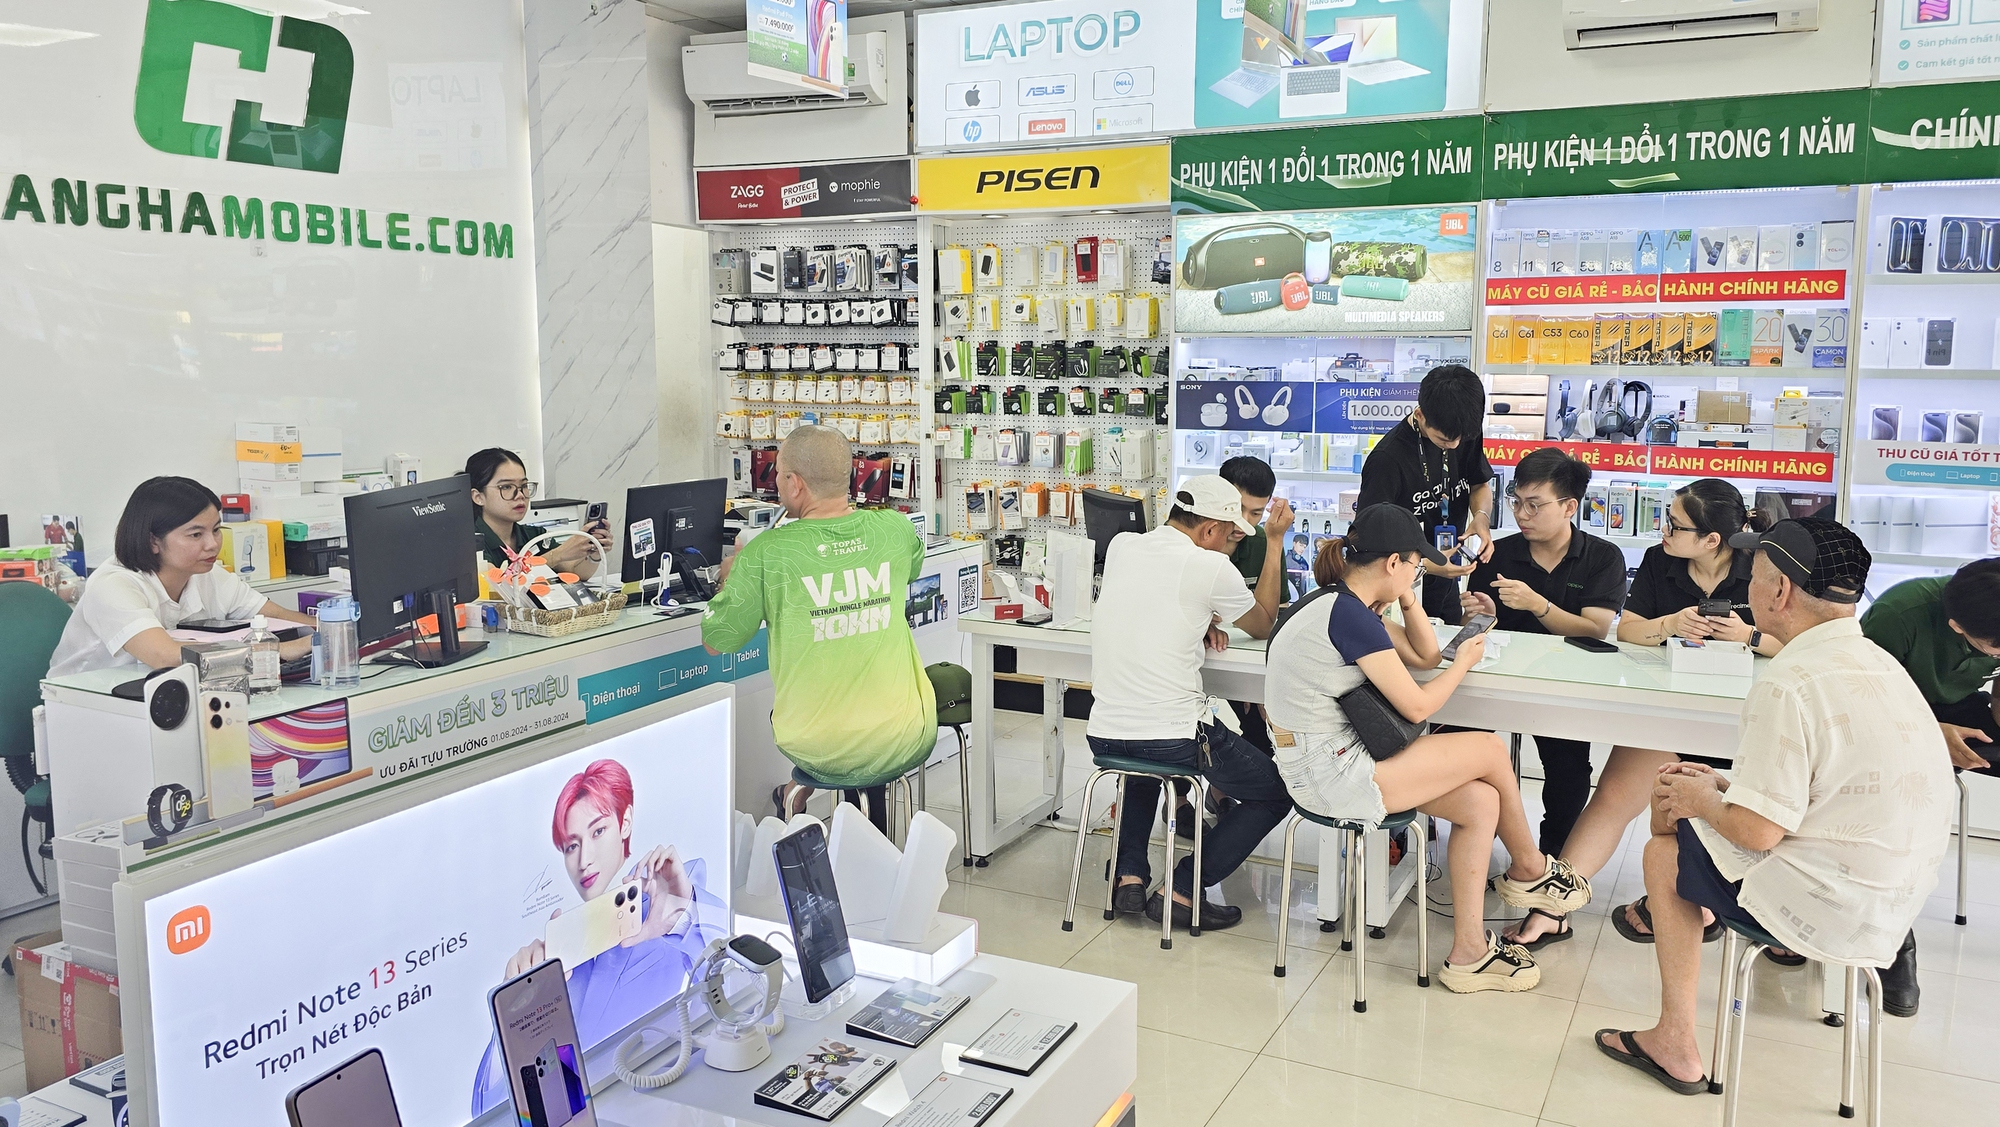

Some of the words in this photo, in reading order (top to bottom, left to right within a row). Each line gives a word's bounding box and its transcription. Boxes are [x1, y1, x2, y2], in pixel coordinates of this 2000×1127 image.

[1229, 6, 1245, 14] CHÍN
[963, 9, 1142, 63] LAPTOP
[1917, 38, 1936, 48] Sản
[1938, 36, 1968, 48] phẩm
[1970, 34, 1993, 44] chất
[1916, 60, 1938, 68] Cam
[1940, 57, 1956, 66] kết
[1958, 56, 1974, 68] giá
[1977, 56, 1991, 64] tốt
[1026, 84, 1066, 97] ASUS
[1115, 80, 1132, 88] DELL
[1031, 122, 1064, 132] Lenovo
[1108, 116, 1144, 128] Microsoft
[965, 120, 980, 142] hp
[1494, 142, 1538, 176] PHỤ
[1544, 134, 1595, 174] KIỆN
[1602, 138, 1612, 165] 1
[1620, 124, 1660, 164] ĐỔI
[1668, 133, 1677, 162] 1
[1686, 128, 1771, 160] TRONG
[1779, 127, 1789, 156] 1
[1798, 117, 1856, 156] NĂM
[1180, 162, 1216, 194] PHỤ
[1221, 155, 1262, 192] KIỆN
[1268, 158, 1276, 184] 1
[1282, 146, 1315, 183] ĐỔI
[1320, 156, 1330, 181] 1
[1335, 150, 1404, 180] TRONG
[1410, 150, 1420, 176] 1
[1426, 141, 1472, 176] NĂM
[840, 178, 880, 192] mophie
[976, 165, 1100, 194] PISEN
[730, 184, 764, 198] ZAGG
[783, 181, 816, 196] PROTECT
[791, 192, 818, 205] POWER
[1446, 218, 1464, 230] JBL
[1494, 260, 1502, 272] 8
[1522, 260, 1533, 272] 11
[1551, 261, 1564, 272] 12
[1315, 290, 1334, 302] JBL
[1488, 282, 1522, 300] MÁY
[1526, 284, 1550, 299] CŨ
[1554, 282, 1584, 298] GIÁ
[1589, 280, 1607, 298] RẺ
[1622, 280, 1657, 296] BẢO
[1664, 279, 1714, 296] HÀNH
[1720, 278, 1778, 295] CHÍNH
[1784, 278, 1839, 294] HÃNG
[1250, 290, 1272, 305] JBL
[1290, 292, 1308, 303] JBL
[1344, 310, 1396, 324] MULTIMEDIA
[1399, 310, 1445, 322] SPEAKERS
[1492, 330, 1508, 338] C61
[1518, 330, 1534, 338] C61
[1542, 328, 1562, 338] C53
[1569, 329, 1589, 338] C60
[1754, 316, 1782, 342] 20
[1816, 316, 1846, 342] 30
[1636, 350, 1650, 364] 12
[1666, 350, 1681, 364] 12
[1698, 350, 1714, 364] 12
[1340, 388, 1359, 398] PHỤ
[1360, 387, 1382, 398] KIỆN
[1351, 404, 1419, 417] 1.000.00
[1484, 445, 1516, 460] MÁY
[1582, 448, 1600, 464] RẺ
[1614, 448, 1648, 468] BẢO
[1654, 453, 1704, 470] HÀNH
[1710, 456, 1766, 474] CHÍNH
[1772, 458, 1827, 476] HÃNG
[1878, 448, 1906, 458] THU
[1910, 448, 1930, 460] CŨ
[1934, 448, 1958, 461] GIÁ
[1962, 448, 1990, 462] TỐT
[1960, 472, 1980, 480] Laptop
[412, 502, 446, 518] ViewSonic
[832, 538, 862, 550] TOPAS
[833, 544, 868, 556] TRAVEL
[801, 562, 890, 608] VJM
[810, 606, 838, 617] VIETNAM
[840, 602, 862, 612] JUNGLE
[864, 596, 891, 608] MARATHON
[810, 604, 891, 642] 10KM
[736, 648, 760, 662] Tablet
[680, 663, 708, 681] Laptop
[592, 690, 615, 707] Điện
[616, 682, 641, 702] thoại
[368, 712, 432, 754] GIẢM
[438, 696, 486, 735] ĐẾN
[490, 689, 508, 718] 3
[510, 674, 570, 712] TRIỆU
[380, 763, 398, 778] ƯU
[399, 754, 419, 774] ĐÃI
[420, 748, 444, 769] TỰU
[446, 734, 488, 760] TRƯỜNG
[490, 724, 528, 744] 01.08.2024
[534, 712, 570, 731] 31.08.2024
[203, 1010, 289, 1070] Redmi
[297, 980, 362, 1024] Note
[367, 960, 396, 991] 13
[404, 928, 470, 976] Series
[510, 1017, 524, 1030] Redmi
[524, 1010, 536, 1022] Note
[536, 1006, 542, 1014] 13
[542, 1002, 554, 1012] Pro+
[255, 1049, 307, 1082] Trọn
[312, 1020, 350, 1055] Nét
[354, 1000, 395, 1044] Độc
[398, 980, 434, 1012] Bản
